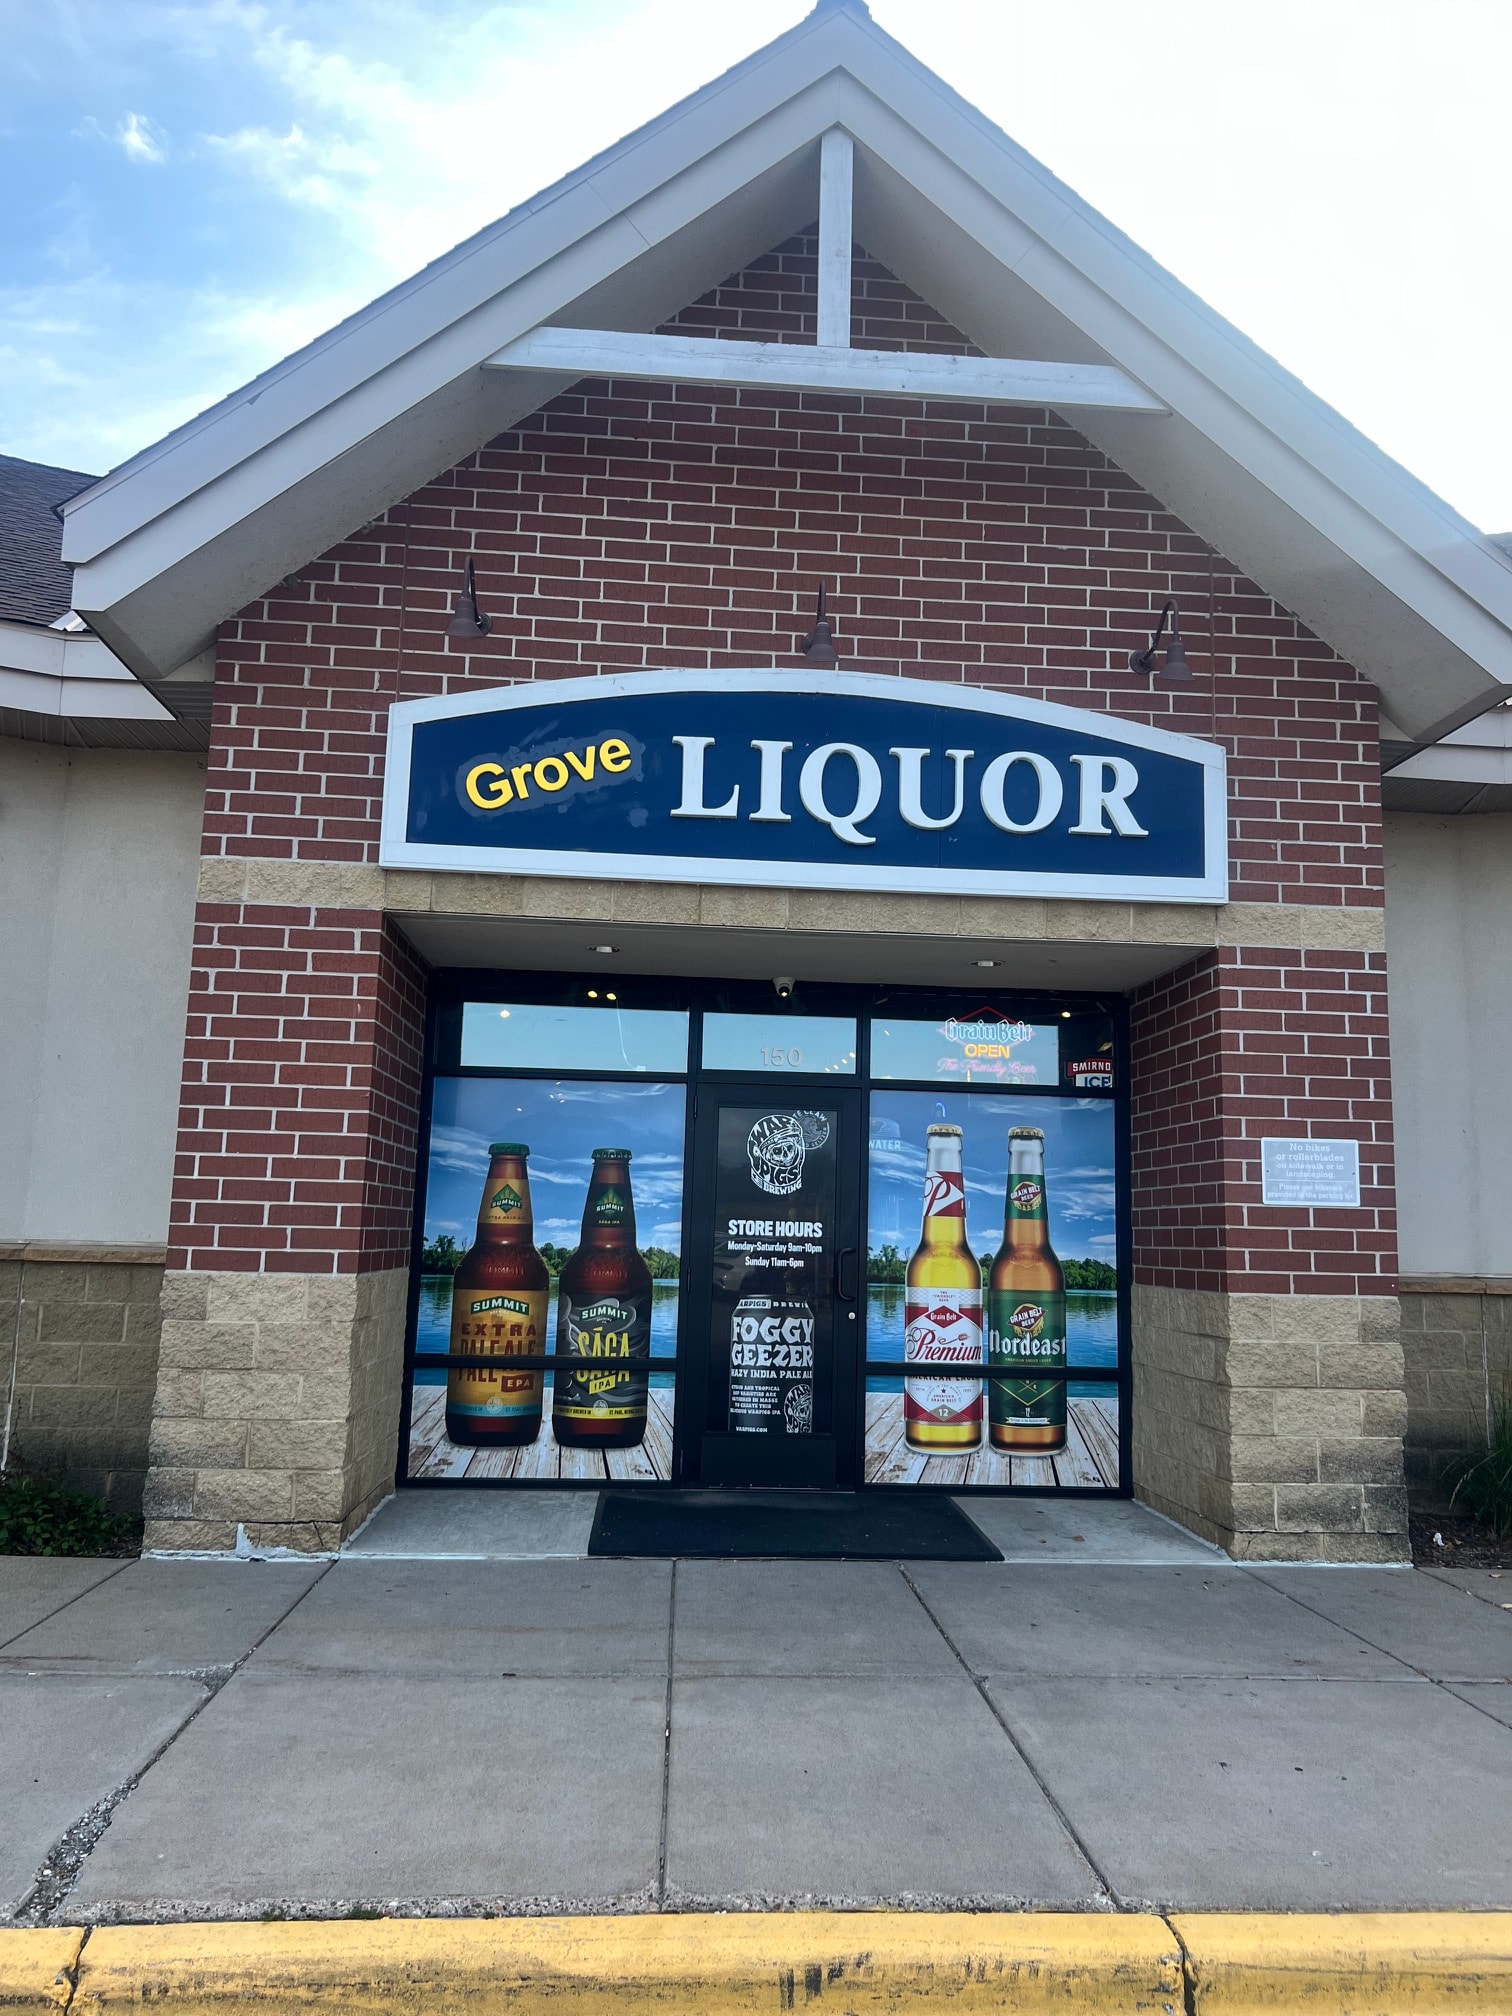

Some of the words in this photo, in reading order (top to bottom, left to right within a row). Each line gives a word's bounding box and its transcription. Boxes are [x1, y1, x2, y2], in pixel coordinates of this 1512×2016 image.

[466, 738, 632, 809] Grove
[670, 736, 1149, 845] LIQUOR
[945, 1017, 996, 1042] Grain
[997, 1018, 1033, 1043] Belt
[760, 1047, 803, 1067] 150
[964, 1043, 1010, 1059] OPEN
[937, 1058, 959, 1072] The
[960, 1058, 1006, 1078] Friendly
[1008, 1061, 1037, 1074] Beer
[1084, 1074, 1111, 1087] ICE
[750, 1115, 802, 1142] WAR
[1289, 1143, 1302, 1151] No
[1306, 1143, 1330, 1152] bikes
[1289, 1153, 1344, 1162] rollerblades
[752, 1159, 802, 1187] PIGS
[1289, 1162, 1324, 1170] sidewalk
[1286, 1171, 1336, 1179] landscaping.
[763, 1179, 802, 1195] BREWING
[1010, 1188, 1028, 1199] GRAIN
[1027, 1185, 1040, 1194] BELT
[492, 1199, 522, 1208] SUMMIT
[596, 1203, 624, 1212] SUMMIT
[728, 1219, 773, 1236] STORE
[775, 1220, 823, 1238] HOURS
[727, 1240, 787, 1253] Monday-Saturday
[788, 1242, 823, 1254] 9am-10pm
[745, 1256, 770, 1268] Sunday
[771, 1257, 804, 1269] 11am-6pm
[473, 1298, 528, 1312] SUMMIT
[582, 1306, 628, 1320] SUMMIT
[930, 1312, 946, 1321] Grain
[946, 1312, 956, 1321] Belt
[1010, 1311, 1029, 1323] GRAIN
[1029, 1307, 1042, 1317] BELT
[462, 1323, 536, 1336] EXTRA
[1022, 1318, 1035, 1327] BEER
[733, 1316, 814, 1344] FOGGY
[906, 1327, 982, 1361] Premium
[989, 1329, 1066, 1356] Nordeast
[732, 1342, 813, 1367] GEEZER
[731, 1369, 749, 1378] HAZY
[751, 1369, 777, 1379] INDIA
[780, 1370, 801, 1379] PALE
[802, 1370, 813, 1379] ALE
[507, 1379, 530, 1387] EPA
[594, 1380, 611, 1390] IPA
[736, 1425, 768, 1433] WARPIGS.COM
